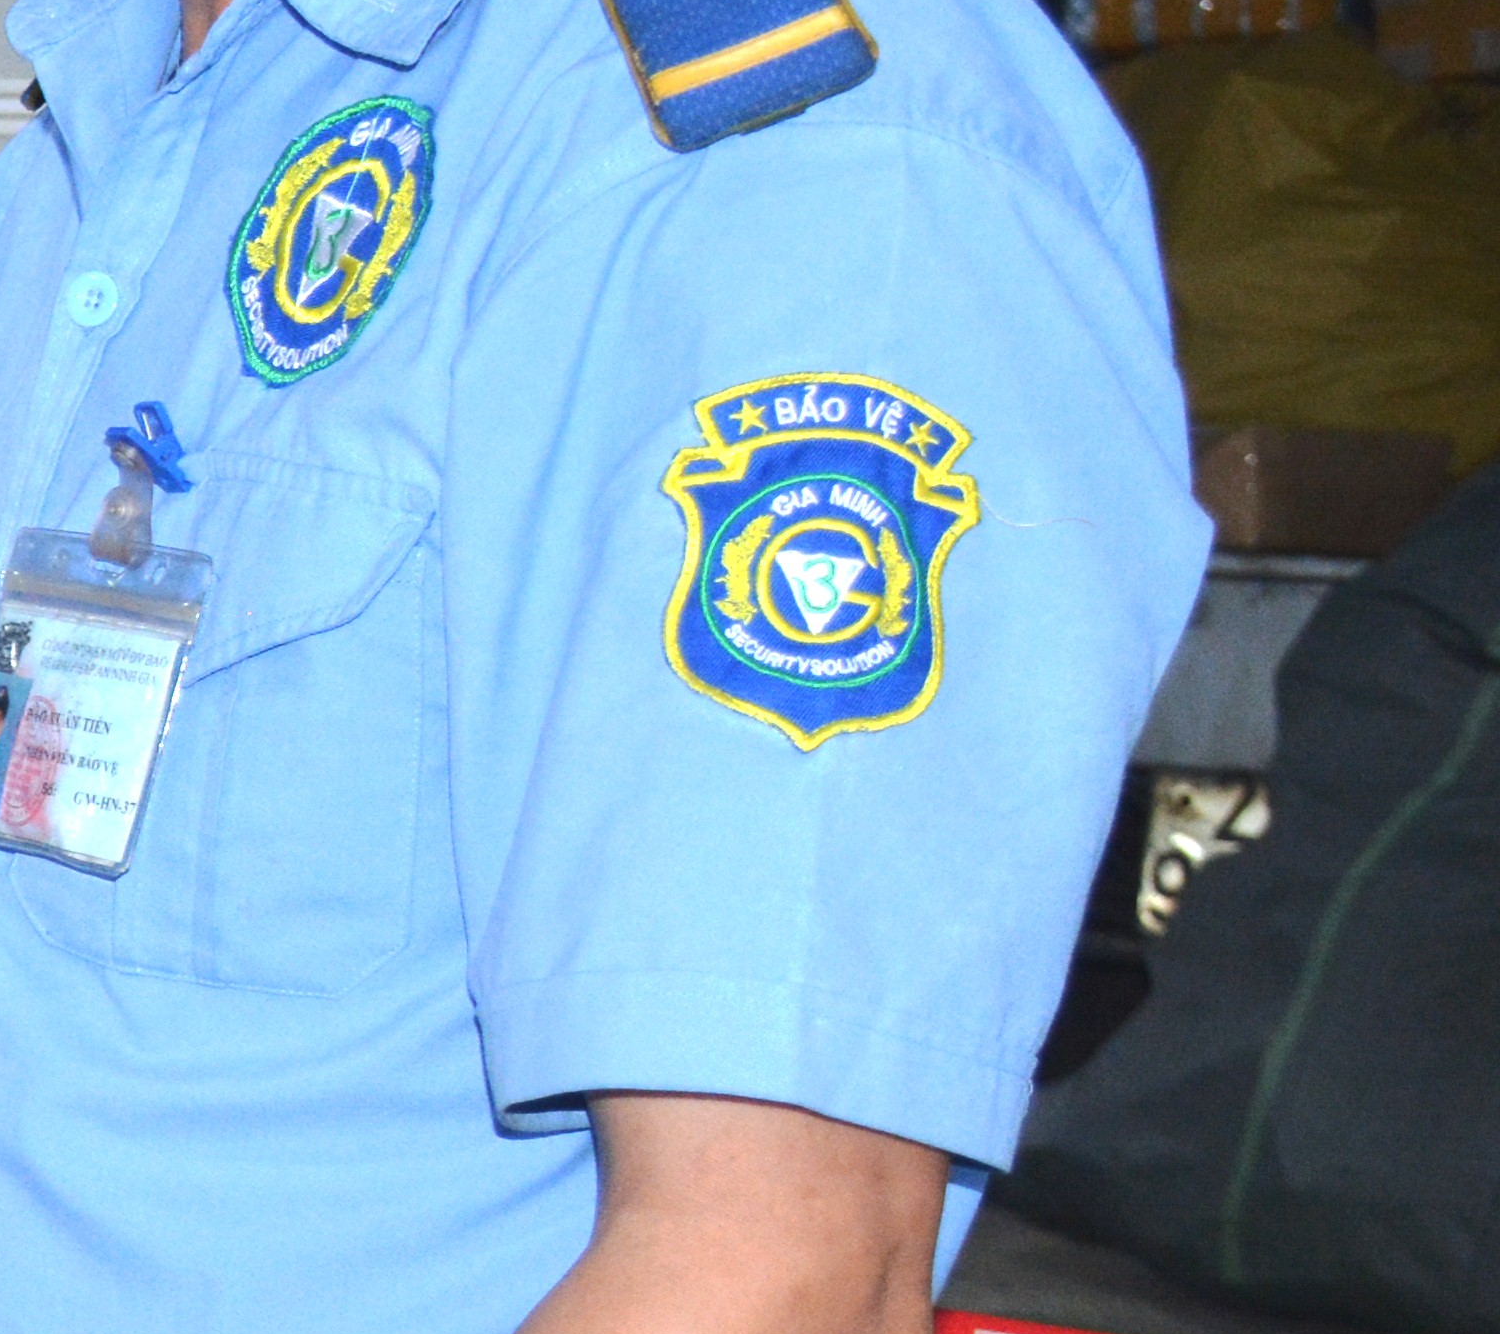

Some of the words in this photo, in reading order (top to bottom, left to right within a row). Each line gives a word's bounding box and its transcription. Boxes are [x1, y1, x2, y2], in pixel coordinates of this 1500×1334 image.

[773, 384, 847, 427] BẢO
[864, 395, 907, 440] VỆ
[771, 489, 819, 519] GIA
[828, 484, 888, 528] MINH
